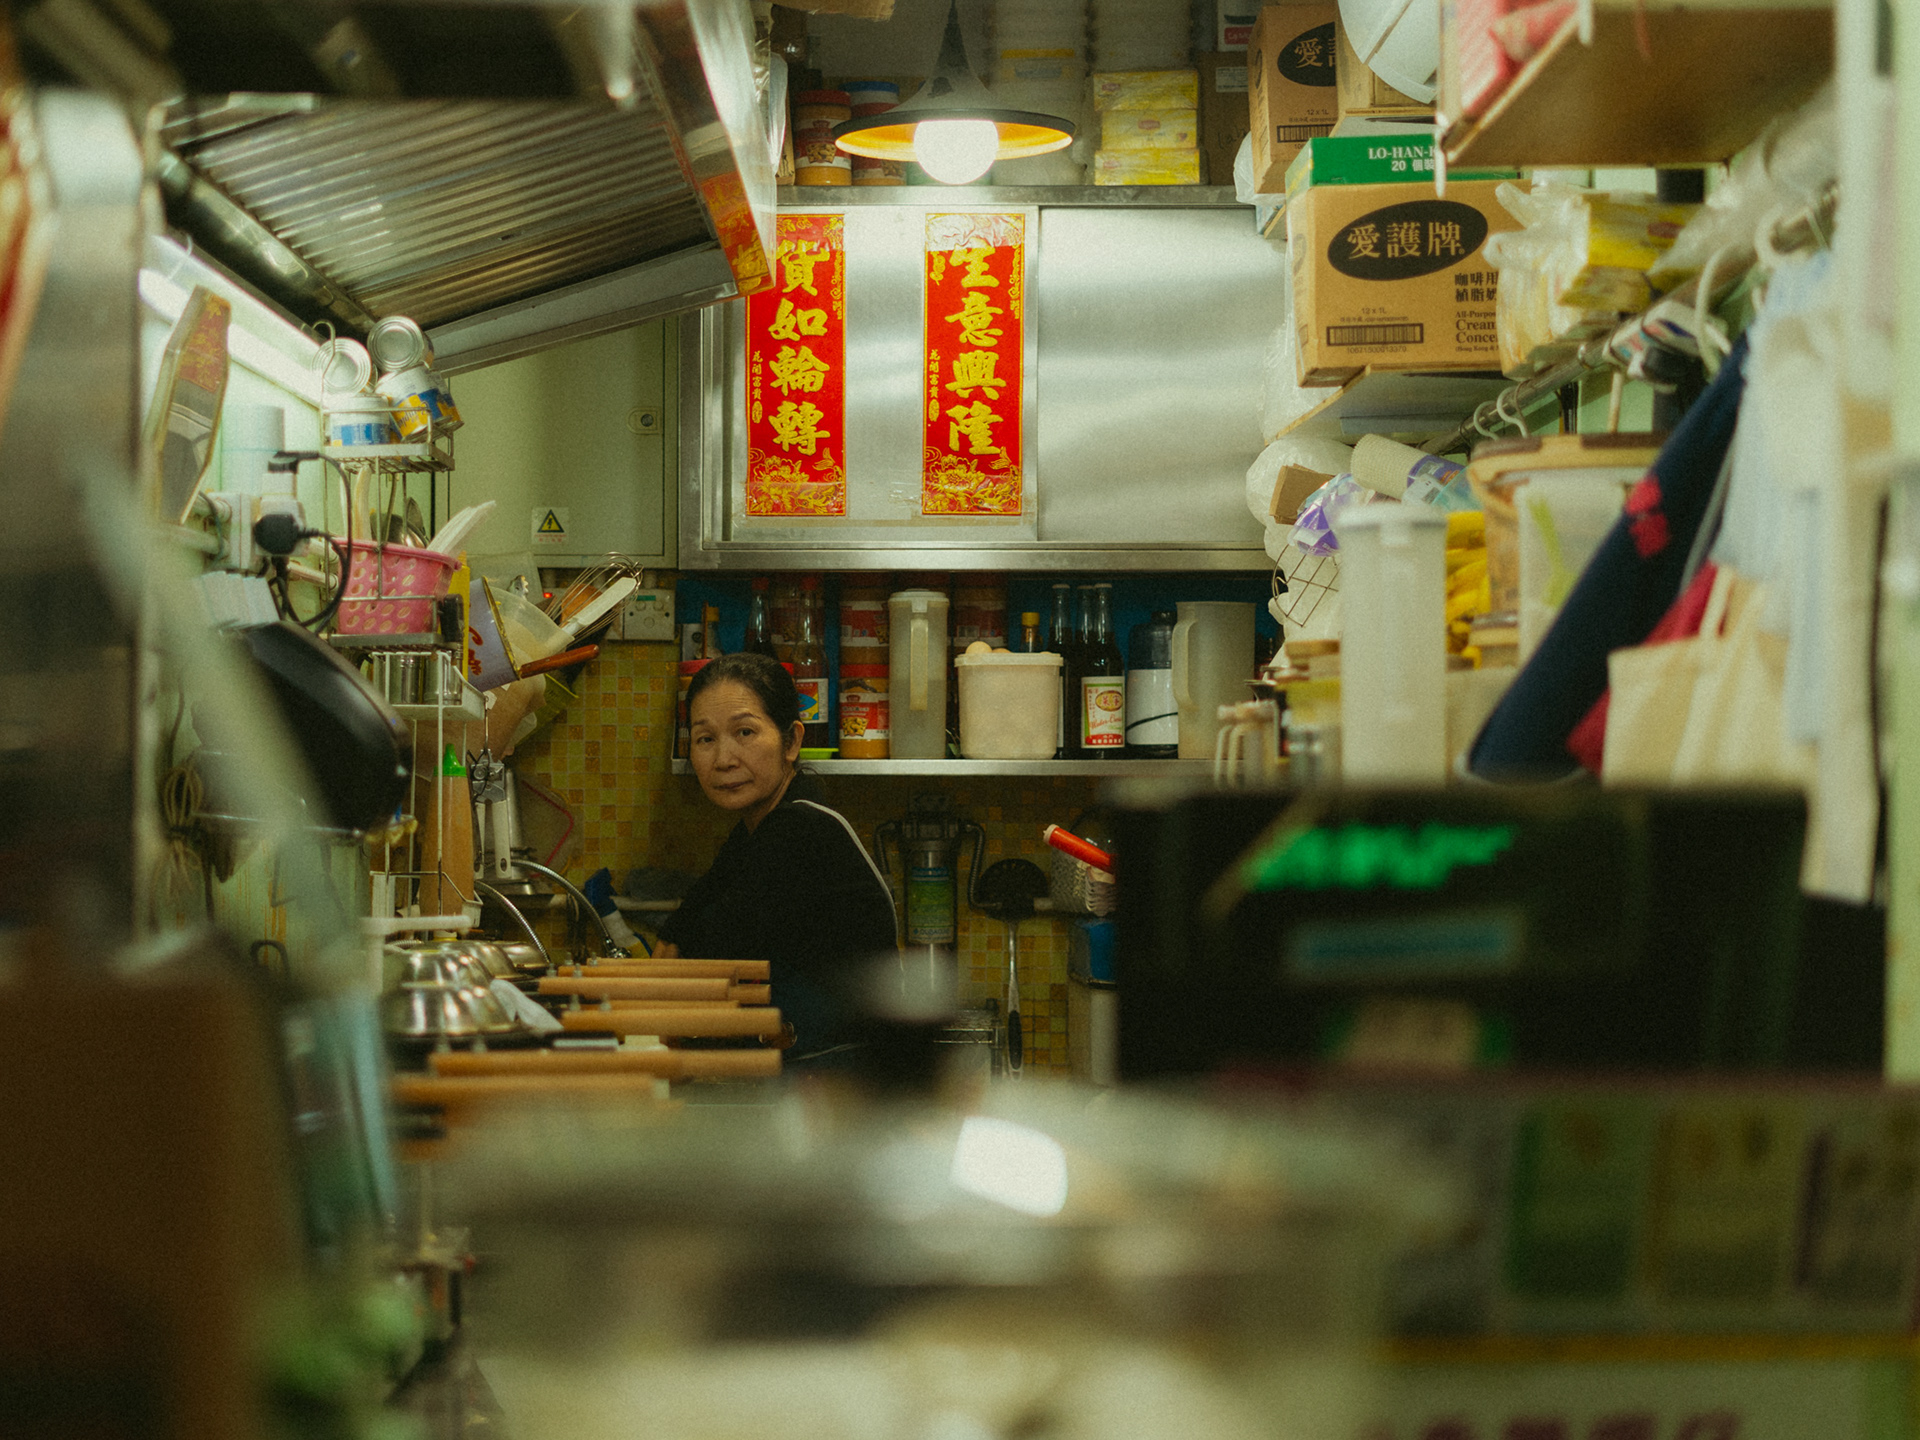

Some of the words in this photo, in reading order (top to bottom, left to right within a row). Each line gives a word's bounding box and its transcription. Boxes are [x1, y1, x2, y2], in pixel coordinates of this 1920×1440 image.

[1391, 160, 1406, 171] 20
[1347, 221, 1461, 259] 愛護牌
[1454, 271, 1499, 286] 咖啡用
[768, 239, 831, 456] 貨如輪轉
[945, 236, 1007, 455] 生意興隆
